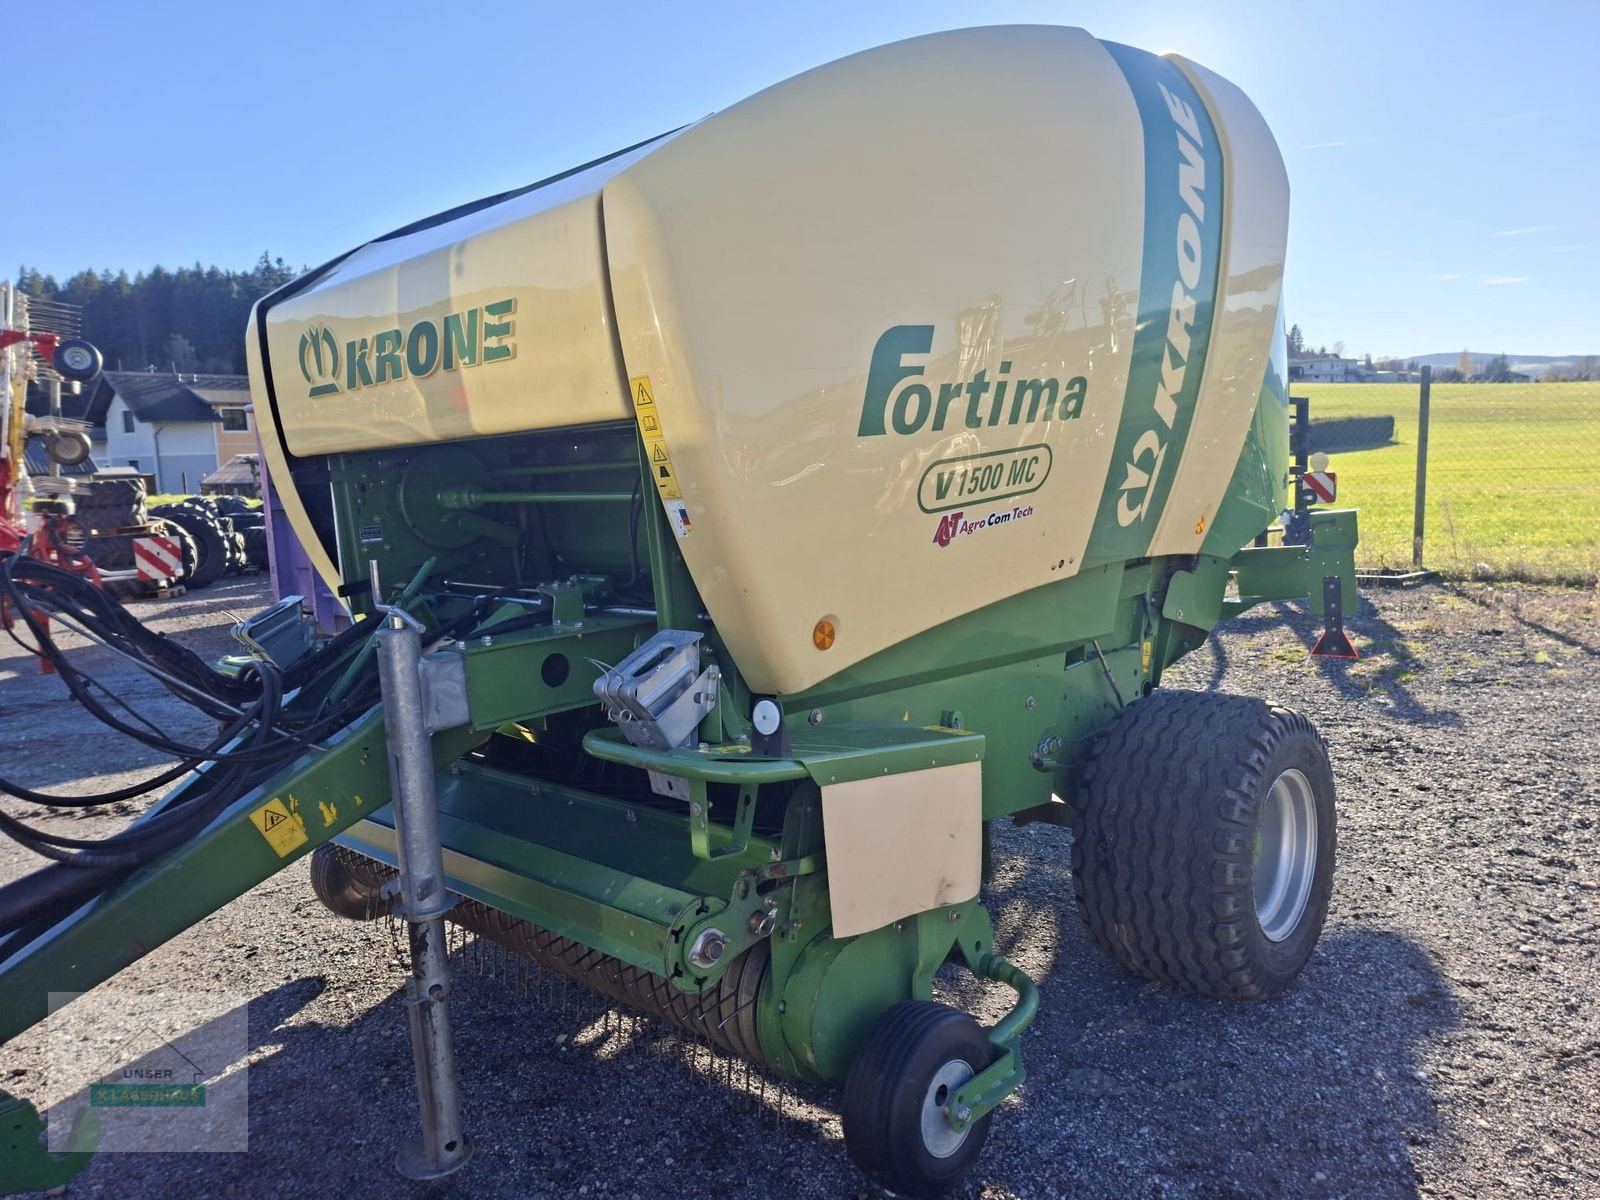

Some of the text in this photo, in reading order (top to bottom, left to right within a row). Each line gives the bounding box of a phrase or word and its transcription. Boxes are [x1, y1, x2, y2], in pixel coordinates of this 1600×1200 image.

[1153, 81, 1206, 431] KRONE
[346, 297, 518, 391] KRONE
[857, 324, 1088, 437] Fortima
[935, 455, 1039, 500] V 1500 MC
[959, 519, 986, 535] Agro
[987, 512, 1011, 526] Com
[1012, 505, 1034, 520] Tech
